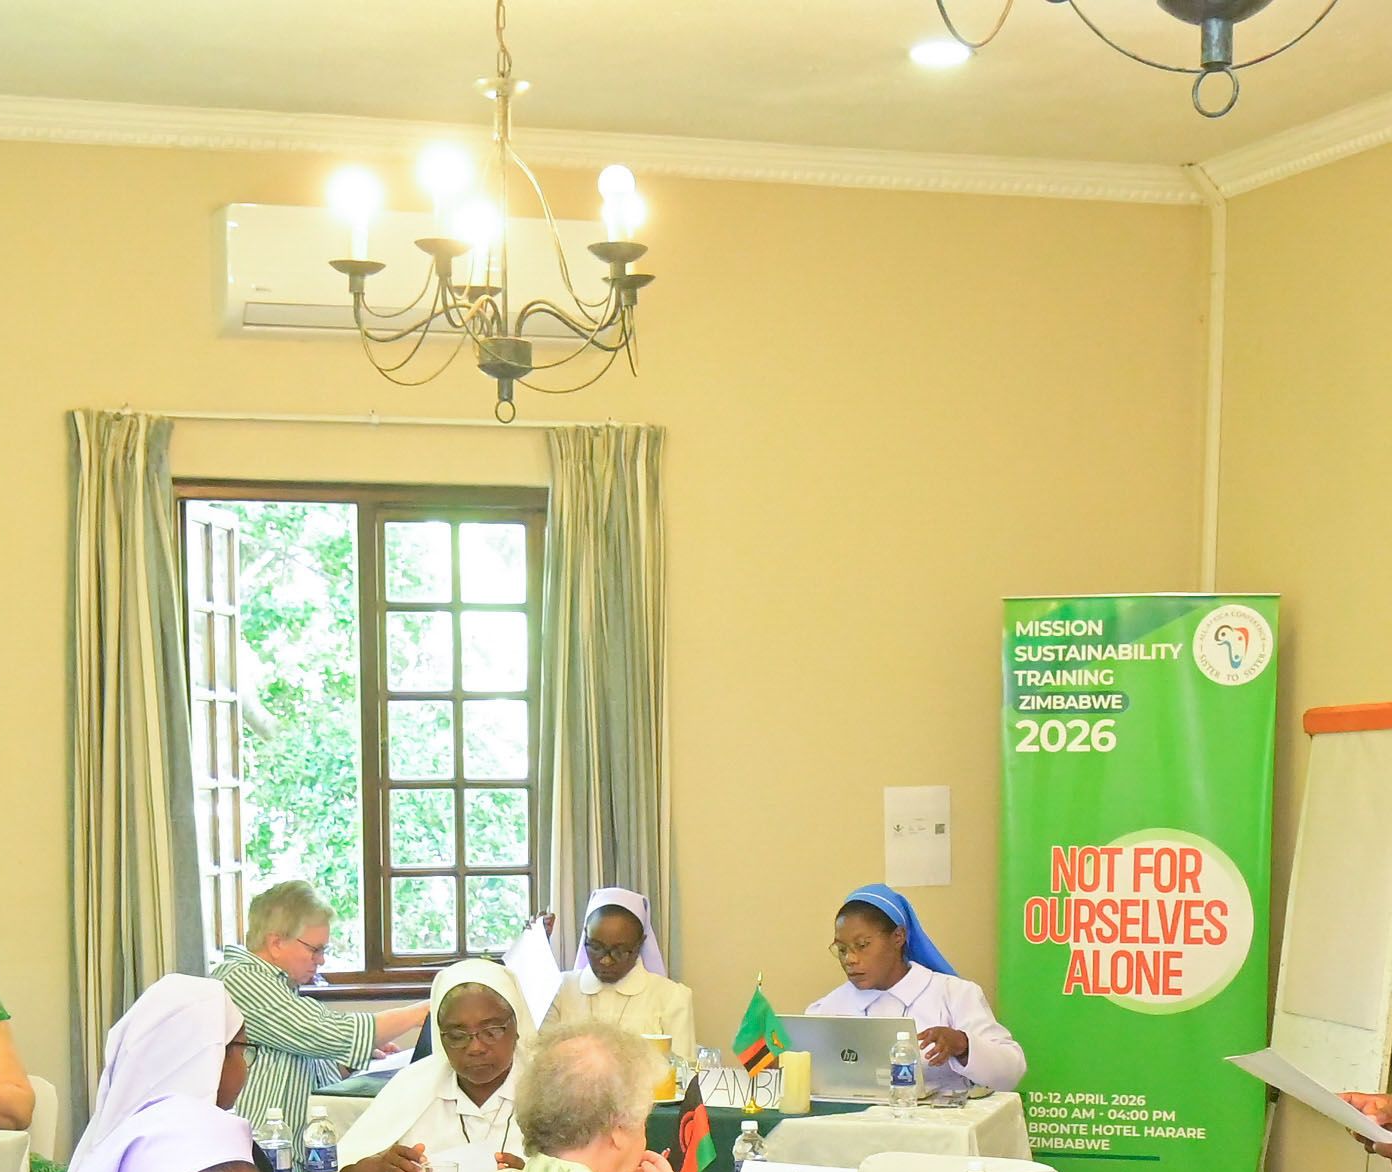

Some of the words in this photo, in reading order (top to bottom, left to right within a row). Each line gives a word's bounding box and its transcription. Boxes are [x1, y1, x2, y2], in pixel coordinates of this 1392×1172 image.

[1015, 619, 1103, 637] MISSION
[1014, 643, 1184, 662] SUSTAINABILITY
[1199, 653, 1221, 679] SISTER
[1226, 673, 1240, 682] TO
[1244, 653, 1267, 677] SISTER
[1013, 669, 1115, 687] TRAINING
[1019, 694, 1123, 710] ZIMBABWE
[1015, 719, 1117, 753] 2026
[1052, 847, 1123, 893] NOT
[1132, 847, 1203, 894] FOR
[1025, 898, 1229, 946] OURSELVES
[1063, 950, 1184, 996] ALONE
[841, 1048, 858, 1063] hp
[691, 1067, 784, 1108] ZAMBI
[1028, 1091, 1062, 1104] 10-12
[1065, 1092, 1108, 1105] APRIL
[1111, 1094, 1147, 1107] 2026
[1028, 1106, 1068, 1119] 09:00
[1071, 1107, 1095, 1120] AM
[1108, 1109, 1149, 1121] 04:00
[1152, 1110, 1176, 1122] PM
[1028, 1122, 1088, 1136] BRONTE
[1092, 1124, 1141, 1138] HOTEL
[1144, 1126, 1207, 1140] HARARE
[1028, 1136, 1111, 1151] ZIMBABWE
